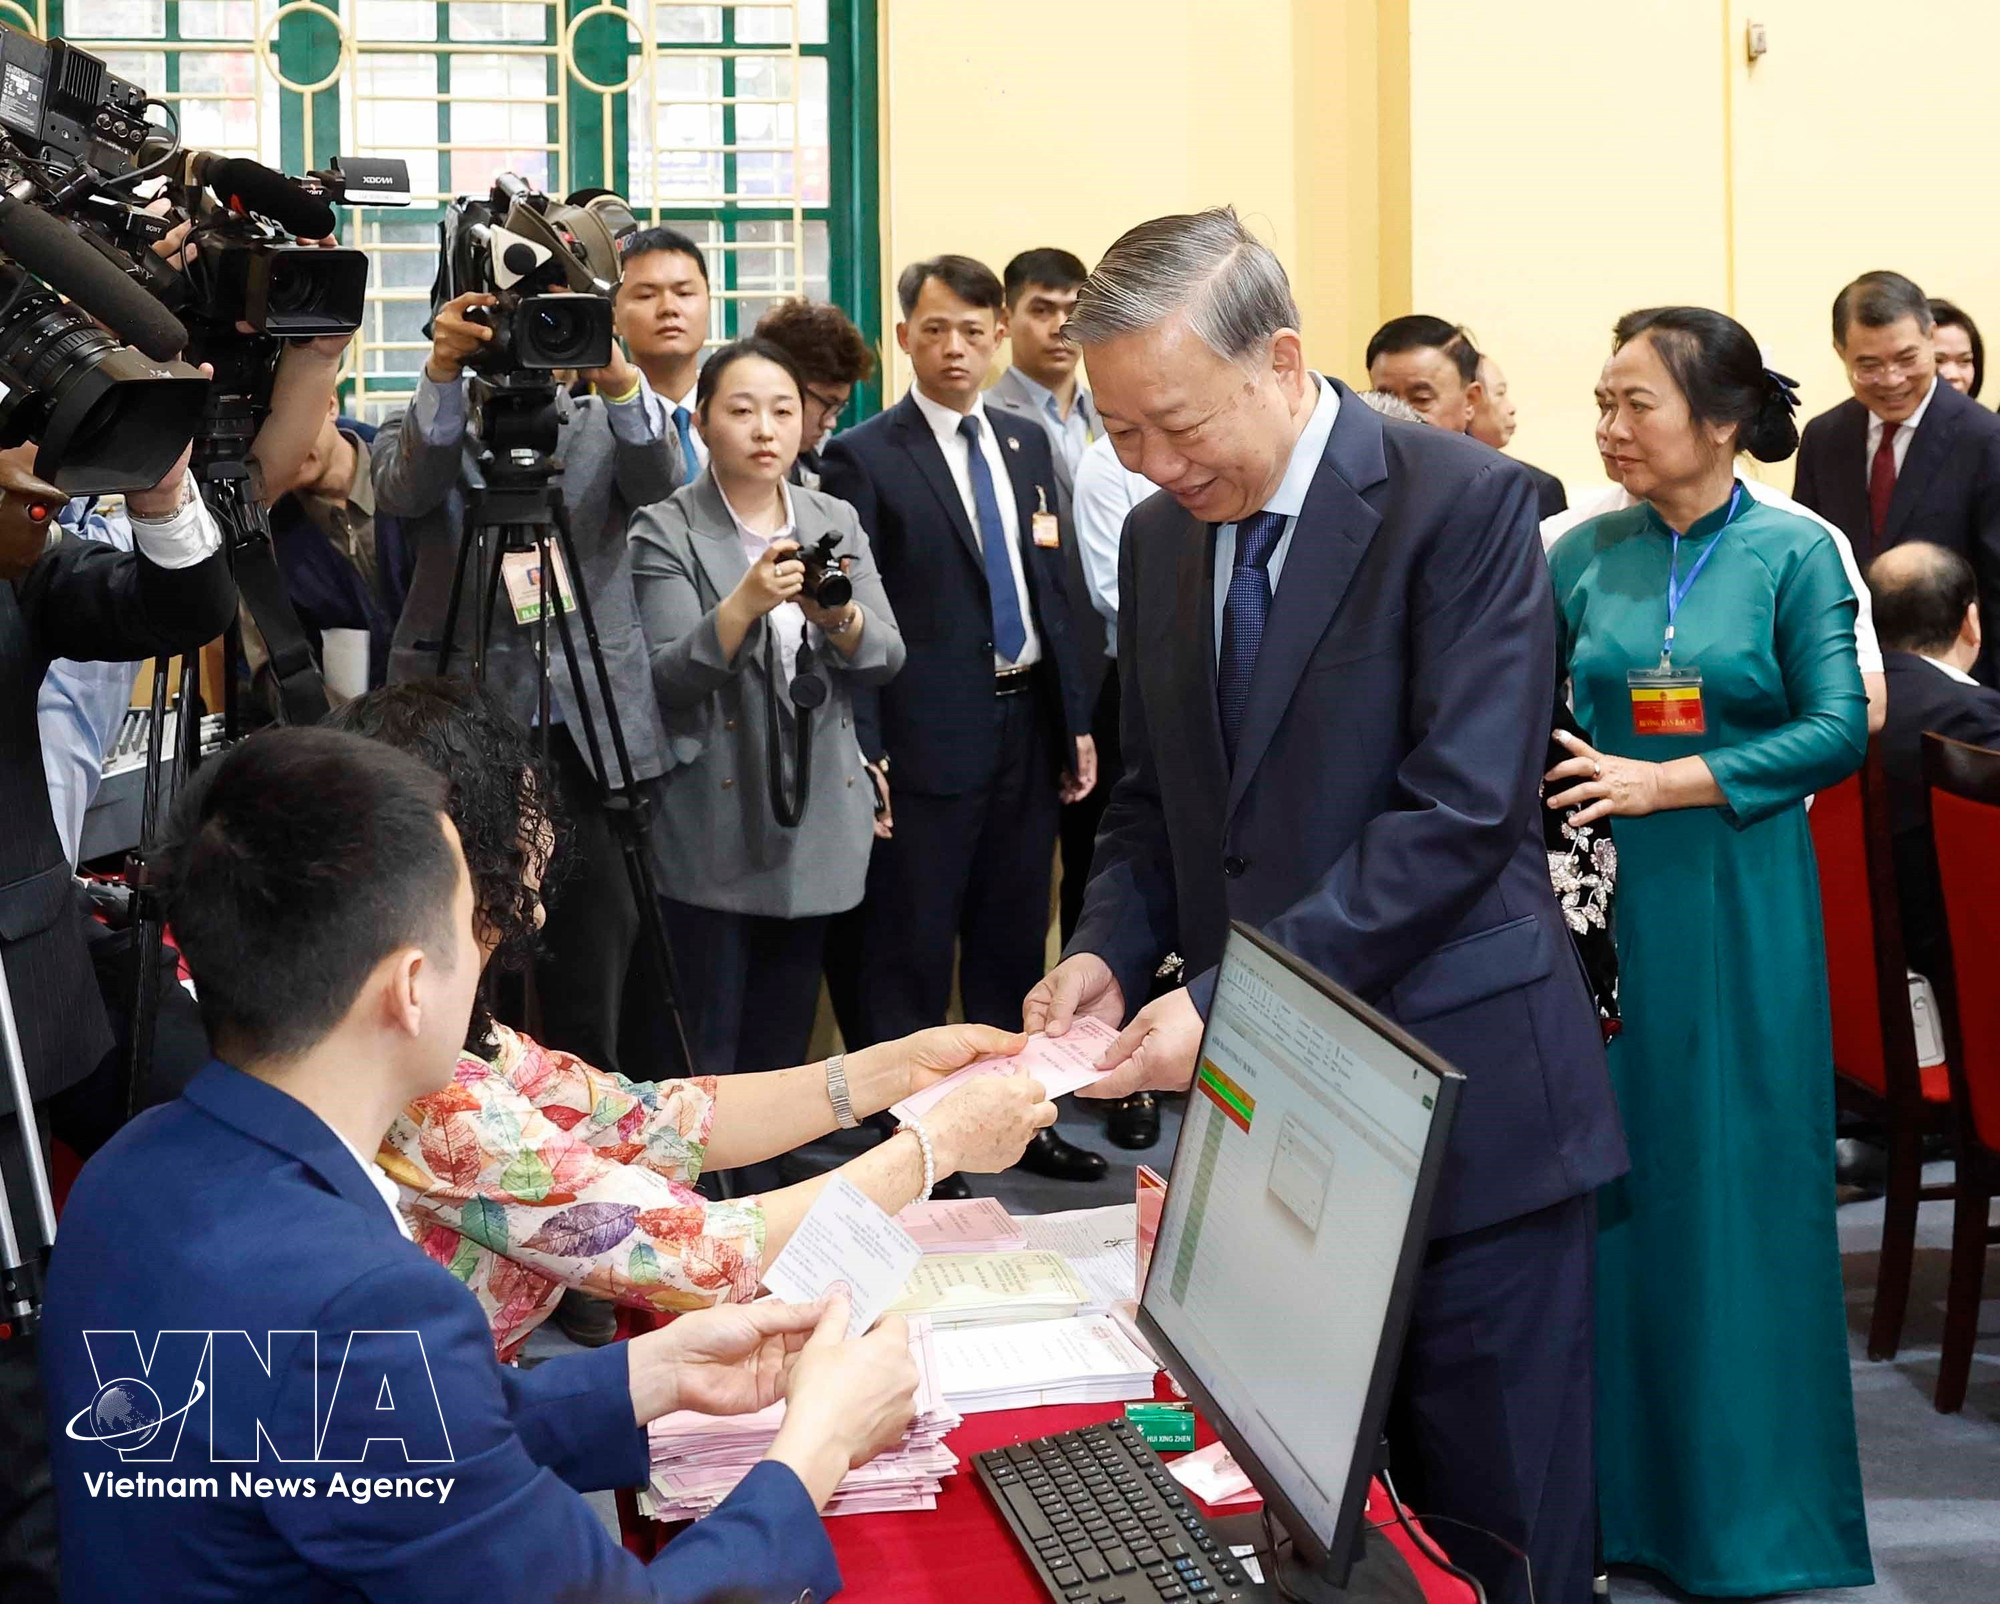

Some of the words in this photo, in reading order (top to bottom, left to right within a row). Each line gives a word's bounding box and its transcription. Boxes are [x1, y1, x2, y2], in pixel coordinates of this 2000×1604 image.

[1146, 1435, 1158, 1443] HUI
[1159, 1435, 1173, 1443] XING
[1174, 1435, 1191, 1443] ZHEN
